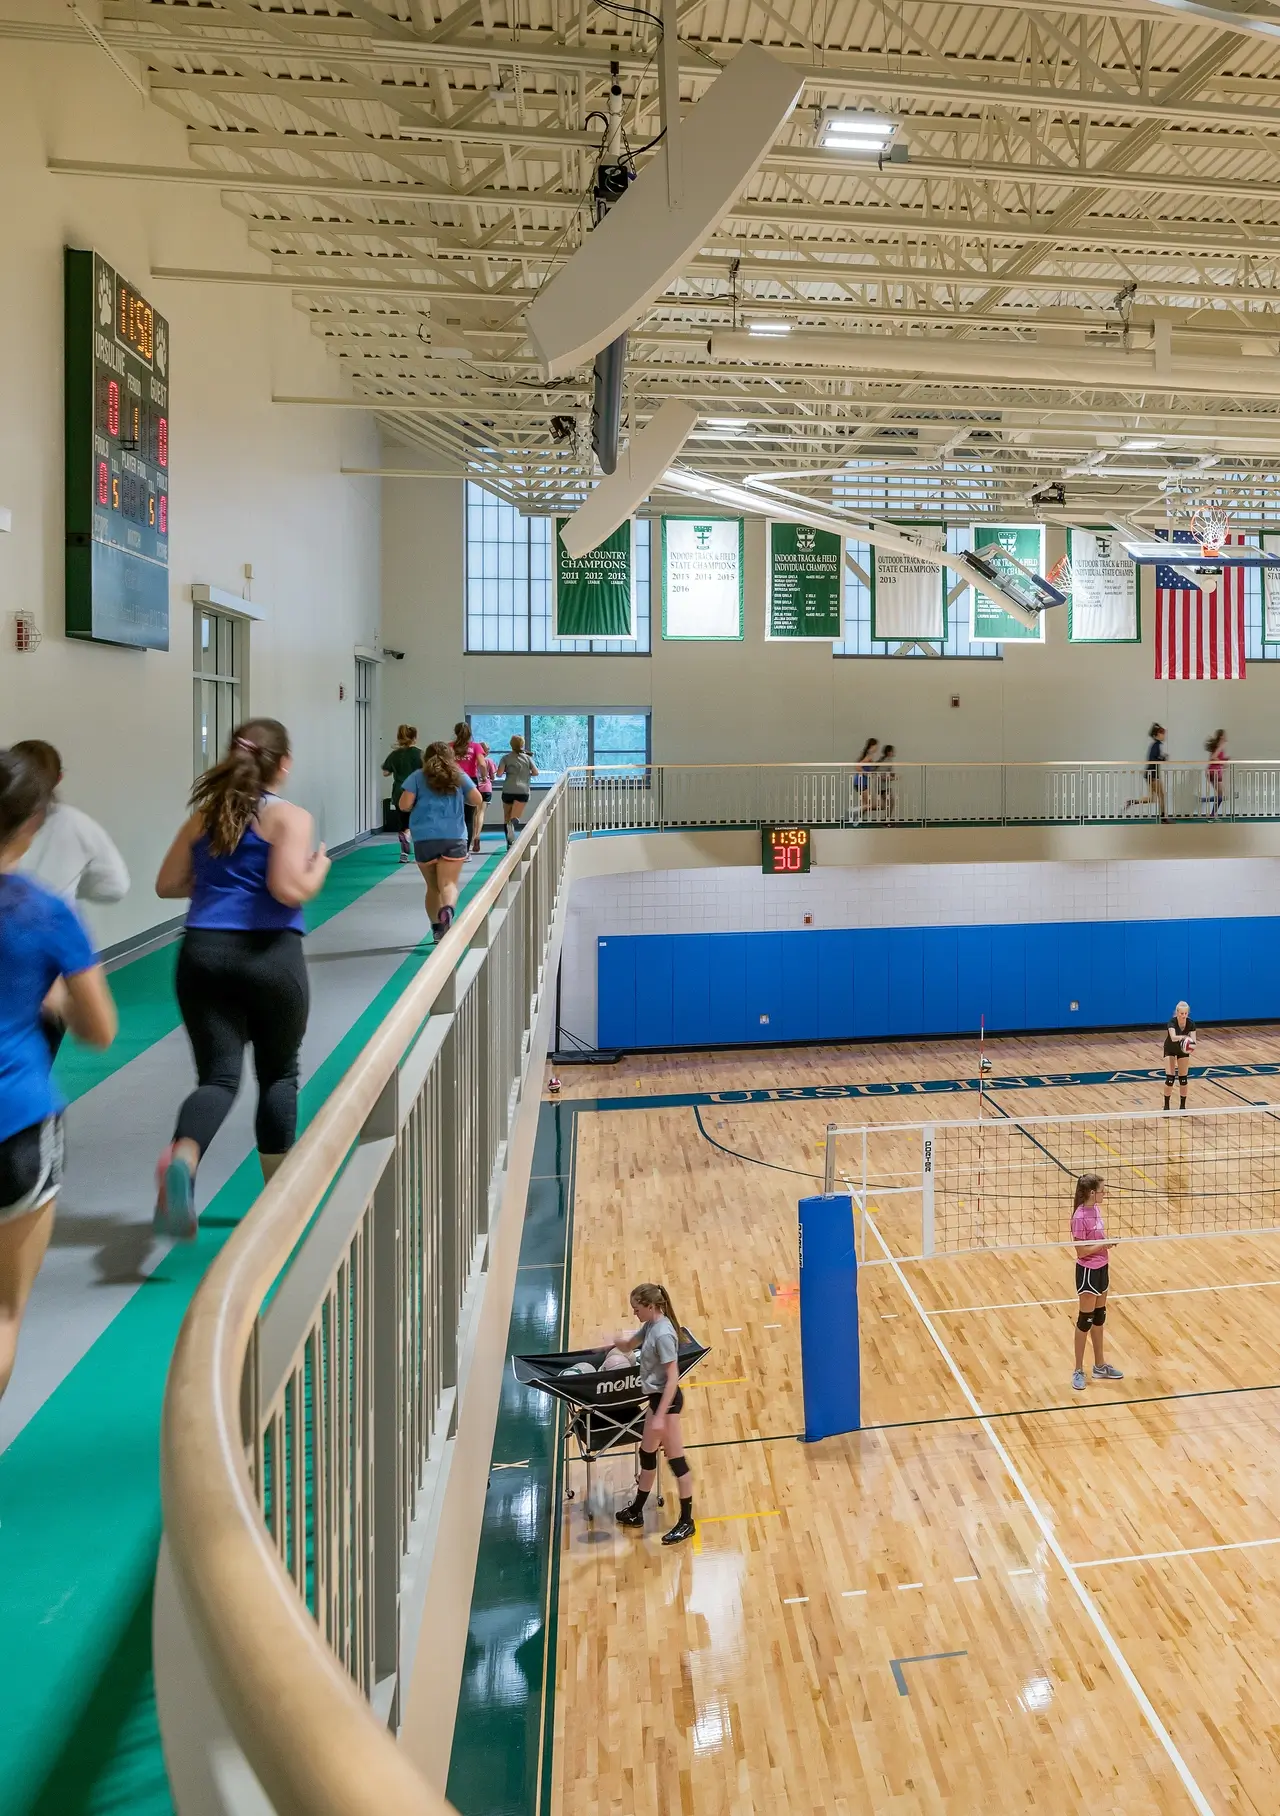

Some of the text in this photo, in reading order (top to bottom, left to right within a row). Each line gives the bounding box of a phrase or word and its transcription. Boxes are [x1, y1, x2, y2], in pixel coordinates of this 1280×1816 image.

[121, 289, 152, 358] 11:50
[95, 331, 125, 376] URSULINE
[150, 376, 167, 408] GUEST
[109, 381, 118, 435] 0
[112, 479, 119, 508] 5
[149, 498, 155, 525] 5
[588, 551, 626, 560] COUNTRY
[670, 552, 693, 560] INDOOR
[695, 552, 713, 560] TRACK
[774, 554, 797, 562] INDOOR
[798, 554, 816, 562] TRACK
[878, 556, 903, 564] OUTDOOR
[561, 560, 626, 568] CHAMPIONS
[693, 562, 736, 570] CHAMPIONS
[774, 563, 805, 571] INDIVIDUAL
[878, 565, 940, 573] STATE CHAMPIONS
[1120, 560, 1133, 568] FIELD
[584, 572, 603, 580] 2012
[607, 572, 626, 580] 2013
[771, 831, 806, 844] 11:50
[774, 846, 800, 870] 30
[709, 1074, 1081, 1103] URSULINE
[596, 1374, 642, 1394] molte
